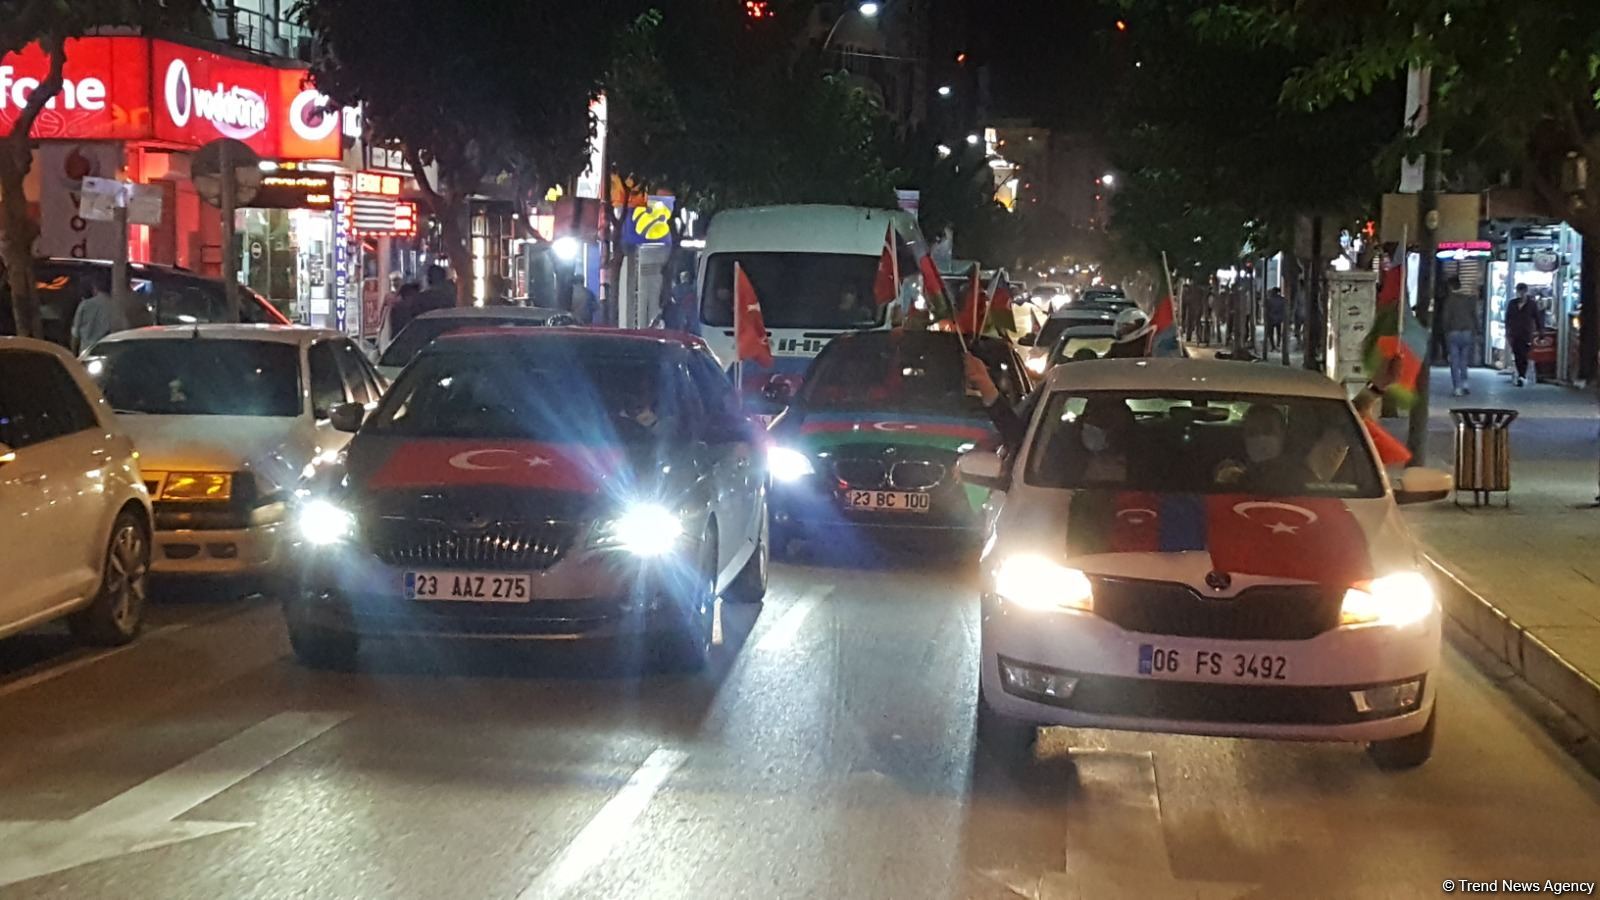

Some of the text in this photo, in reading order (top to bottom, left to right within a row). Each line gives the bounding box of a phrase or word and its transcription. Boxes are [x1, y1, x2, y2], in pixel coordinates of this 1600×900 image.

[193, 82, 266, 130] vodafone
[854, 492, 929, 508] 23 BC 100
[417, 575, 438, 595] 23
[452, 576, 485, 598] AAZ
[492, 577, 525, 598] 275
[1153, 649, 1179, 672] 06
[1196, 651, 1222, 675] FS
[1234, 654, 1286, 680] 3492
